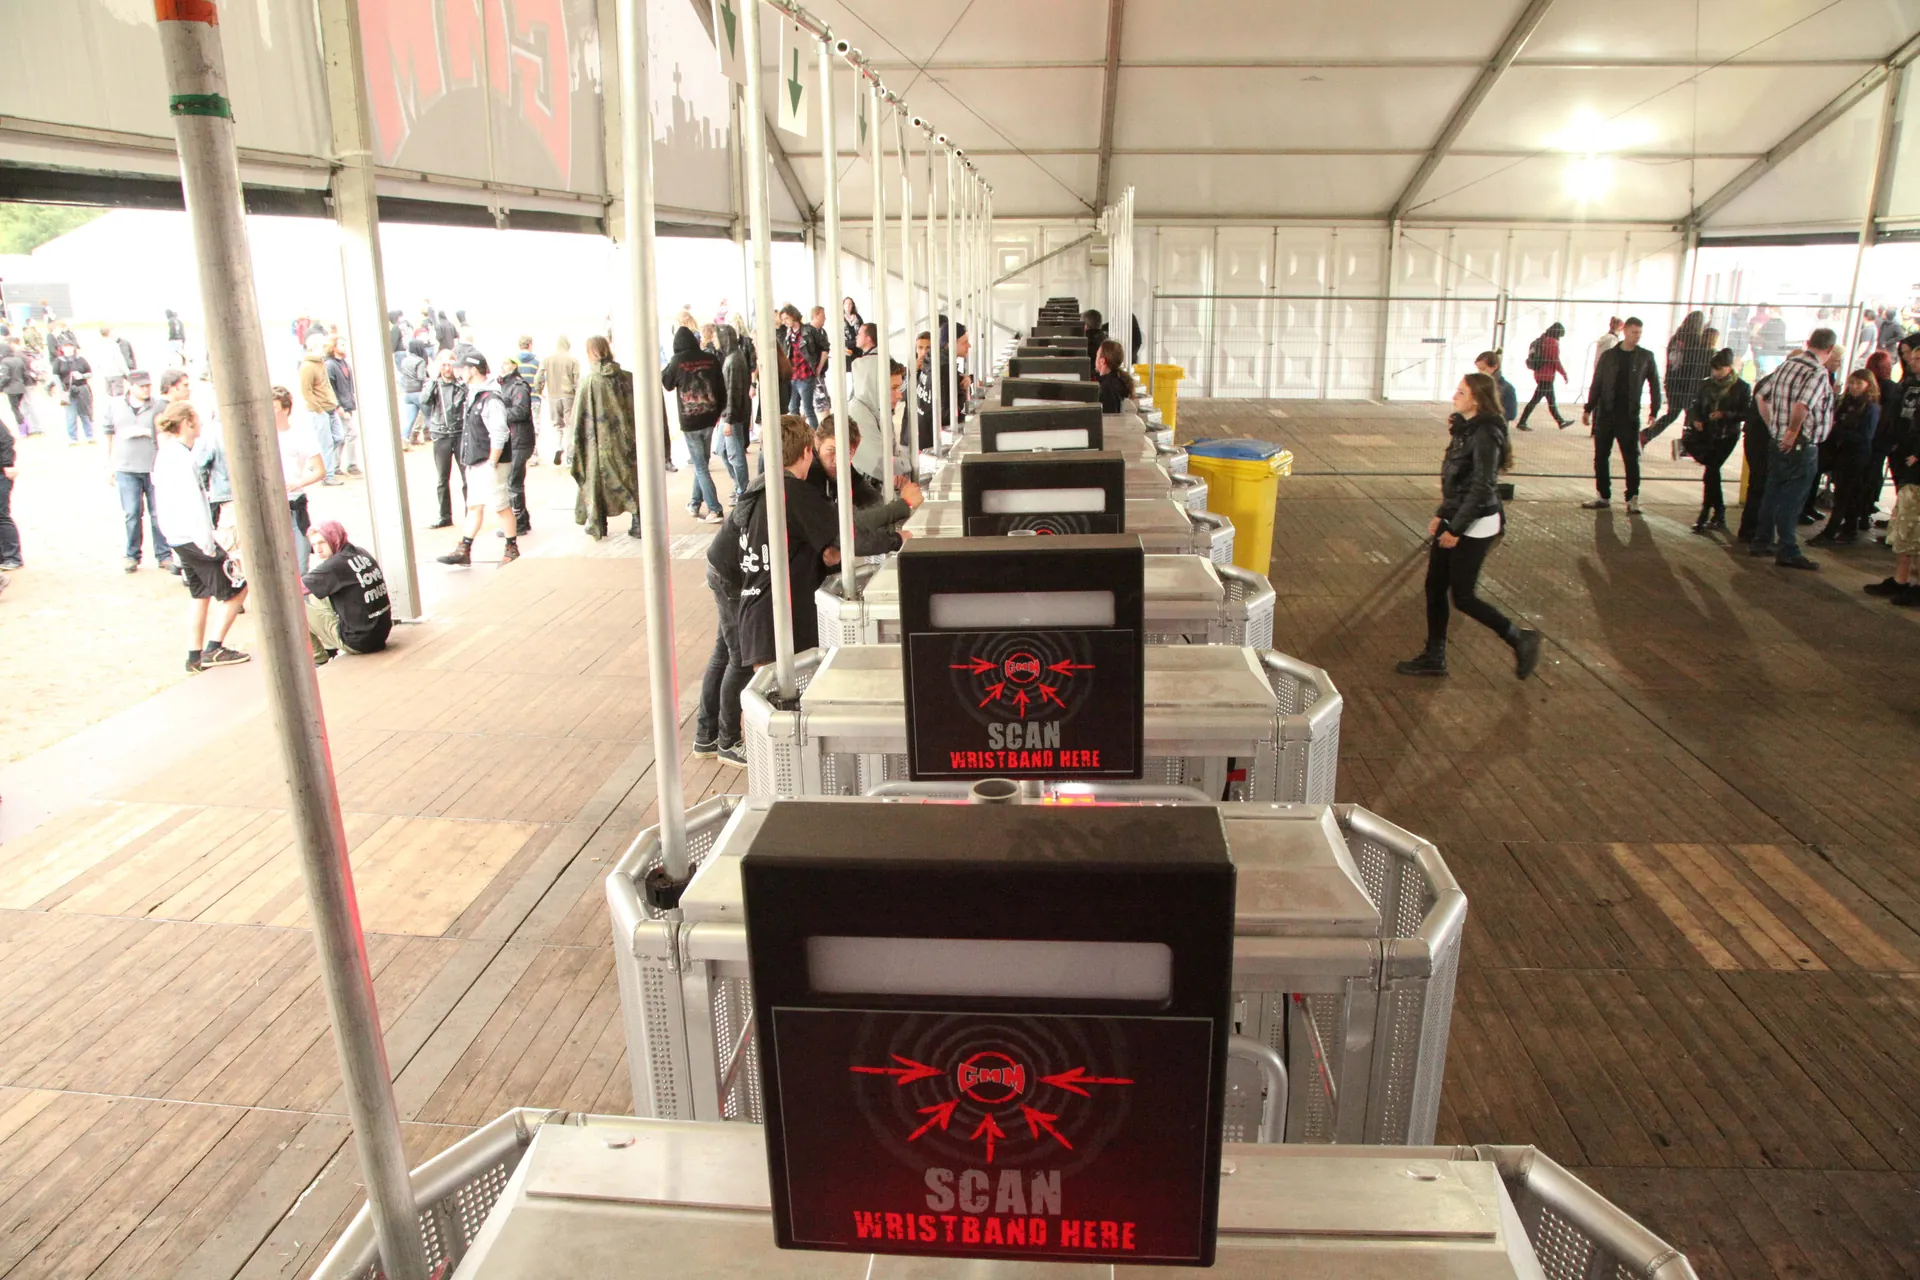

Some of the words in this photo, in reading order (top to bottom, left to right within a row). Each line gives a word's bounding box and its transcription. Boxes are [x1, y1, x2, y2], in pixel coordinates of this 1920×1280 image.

[347, 554, 373, 573] We
[355, 567, 383, 588] love
[1004, 659, 1041, 678] GMM
[987, 720, 1061, 750] SCAN
[950, 750, 1054, 769] WRISTBAND
[1059, 750, 1100, 768] HERE
[957, 1062, 1026, 1095] GMM
[924, 1166, 1062, 1216] SCAN
[853, 1210, 1048, 1247] WRISTBAND
[1061, 1219, 1137, 1250] HERE
